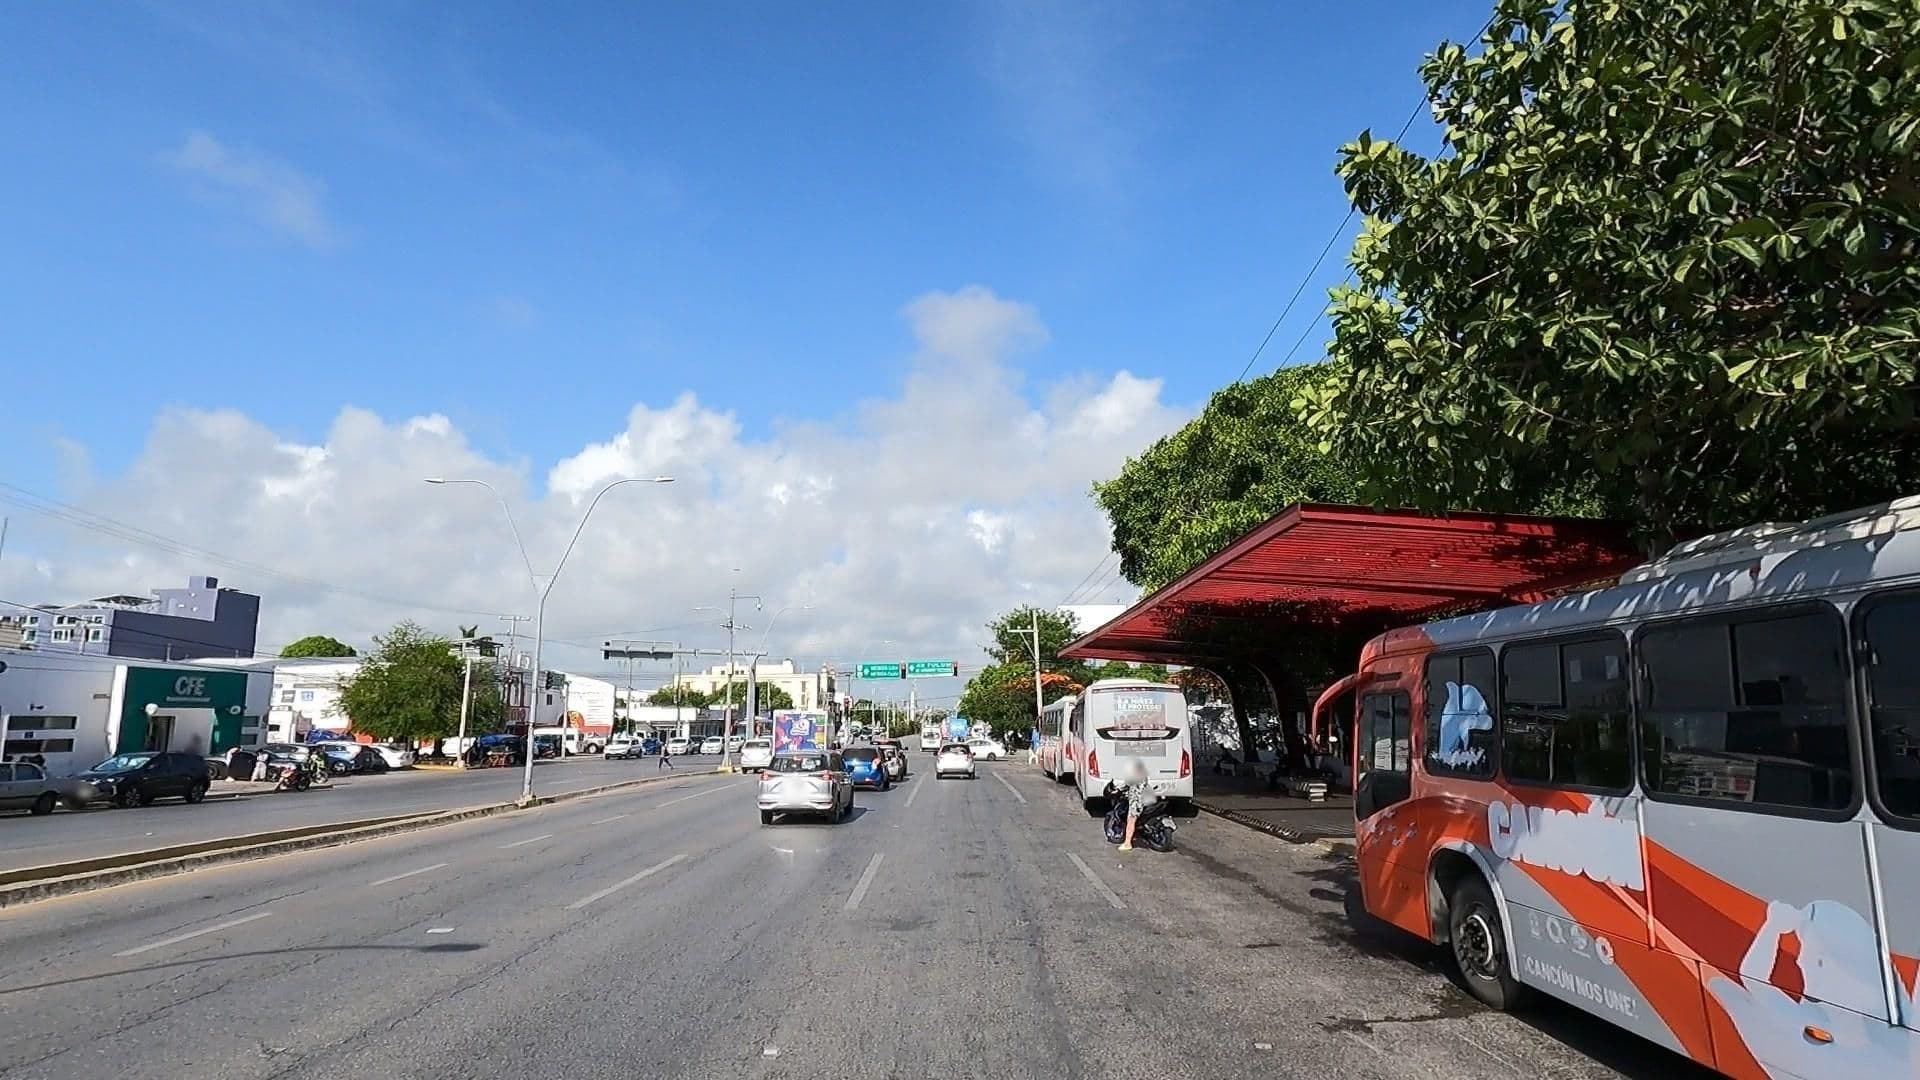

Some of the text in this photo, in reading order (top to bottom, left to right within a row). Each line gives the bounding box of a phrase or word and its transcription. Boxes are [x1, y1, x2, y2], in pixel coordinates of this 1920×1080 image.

[175, 676, 206, 696] CFE
[1575, 974, 1603, 1004] NOS
[1603, 986, 1639, 1019] UNE!
